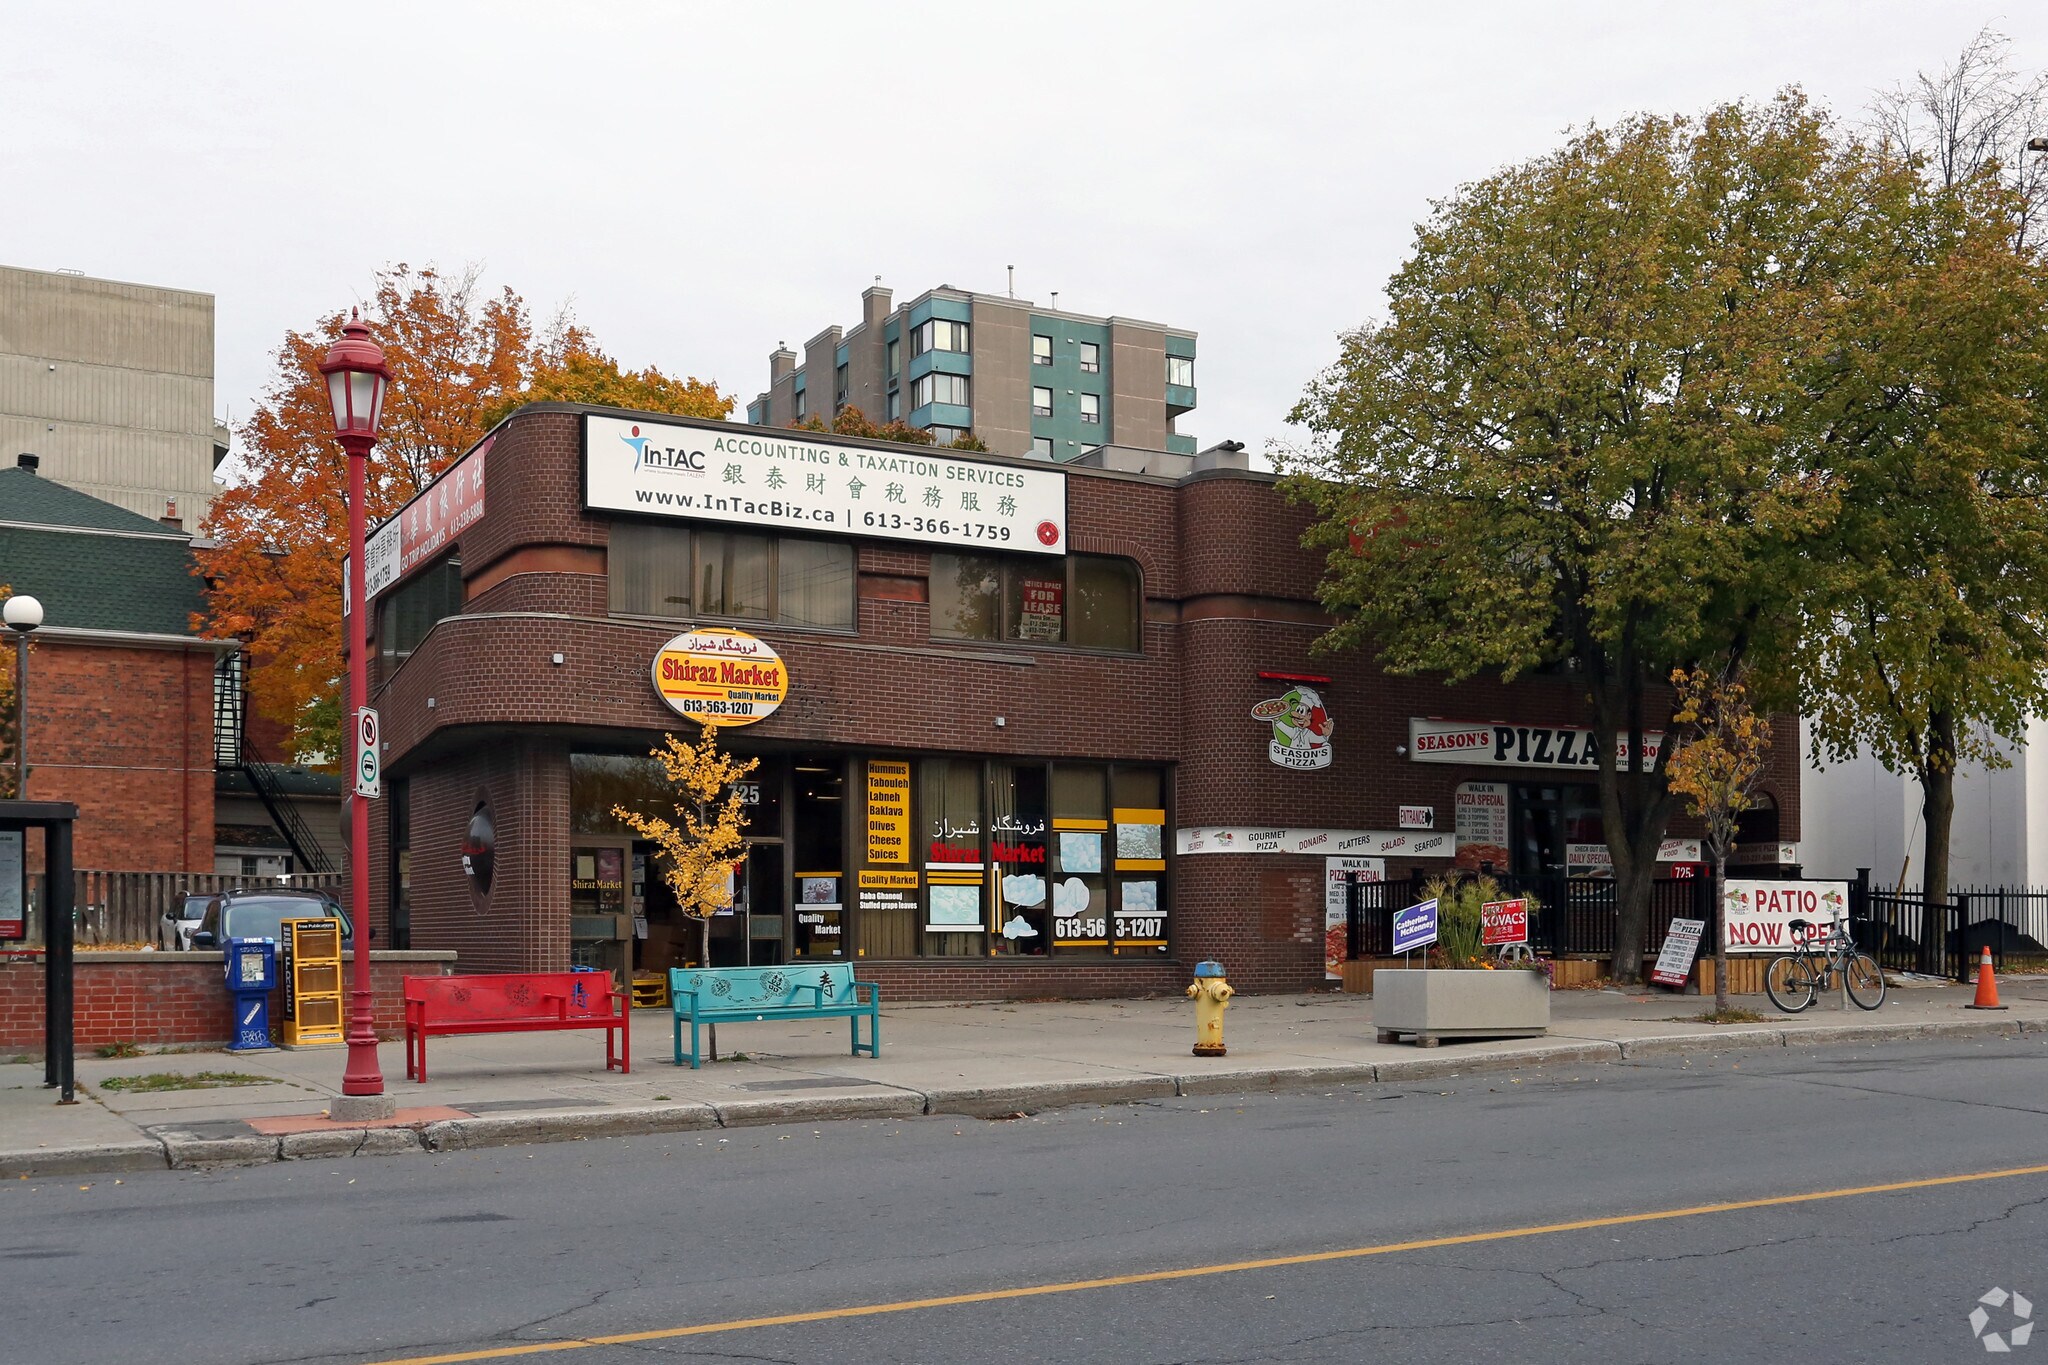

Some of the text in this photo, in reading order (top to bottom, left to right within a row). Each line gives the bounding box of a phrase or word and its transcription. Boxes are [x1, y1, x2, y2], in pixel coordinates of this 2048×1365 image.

[644, 445, 706, 471] In-TAC
[714, 437, 1025, 488] ACCOUNTING & TAXATION SERVICES
[635, 490, 835, 522] www.InTacBiz.ca
[863, 511, 1011, 541] 613-366-1759
[420, 527, 446, 558] HOLIDAYS
[1030, 590, 1055, 602] FOR
[1024, 601, 1062, 614] LEASE
[688, 637, 757, 654] فروشگاه شیراز
[662, 658, 779, 687] Shiraz Market
[728, 690, 779, 702] Quality Market
[684, 699, 753, 715] 613-563-1207
[1273, 745, 1328, 759] SEASON'S
[1417, 732, 1489, 751] SEASON'S
[1493, 727, 1600, 766] PIZZA
[1284, 757, 1316, 767] PIZZA
[869, 763, 906, 775] Hummus
[869, 777, 909, 788] Tabouleh
[1468, 784, 1494, 793] WALK IN
[728, 785, 760, 803] 725
[869, 792, 900, 802] Labneh
[1457, 793, 1505, 806] PIZZA SPECIAL
[869, 806, 903, 817] Baklava
[1401, 809, 1425, 824] ENTRANCE
[869, 820, 896, 831] Olives
[932, 814, 1045, 838] فروشگاه شیراز
[869, 835, 901, 845] Cheese
[1192, 830, 1201, 840] FREE
[1248, 830, 1287, 842] GOURMET
[1188, 840, 1205, 852] DELIVERY
[1256, 841, 1278, 851] PIZZA
[1298, 833, 1328, 850] DONAIRS
[1338, 834, 1371, 850] PLATTERS
[1381, 836, 1406, 851] SALADS
[1414, 836, 1443, 853] SEAFOOD
[1660, 840, 1683, 851] MEXICAN
[869, 849, 899, 860] Spices
[930, 842, 1045, 862] Shiraz Market
[1569, 853, 1585, 863] DAILY
[1664, 849, 1678, 858] FOOD
[1342, 860, 1370, 868] WALK IN
[572, 880, 622, 889] Shiraz Market
[861, 875, 916, 885] Quality Market
[860, 892, 902, 901] Baba Ghanouj
[1755, 890, 1817, 913] PATIO
[860, 901, 917, 911] Stuffed grape leaves
[798, 913, 824, 924] Quality
[1396, 914, 1428, 930] Catherine
[1484, 912, 1525, 927] KOVACS
[815, 925, 841, 934] Market
[1055, 918, 1162, 938] 613-56 3-1207
[1400, 920, 1434, 937] McKenney
[1681, 926, 1701, 935] PIZZA
[1729, 922, 1783, 945] NOW
